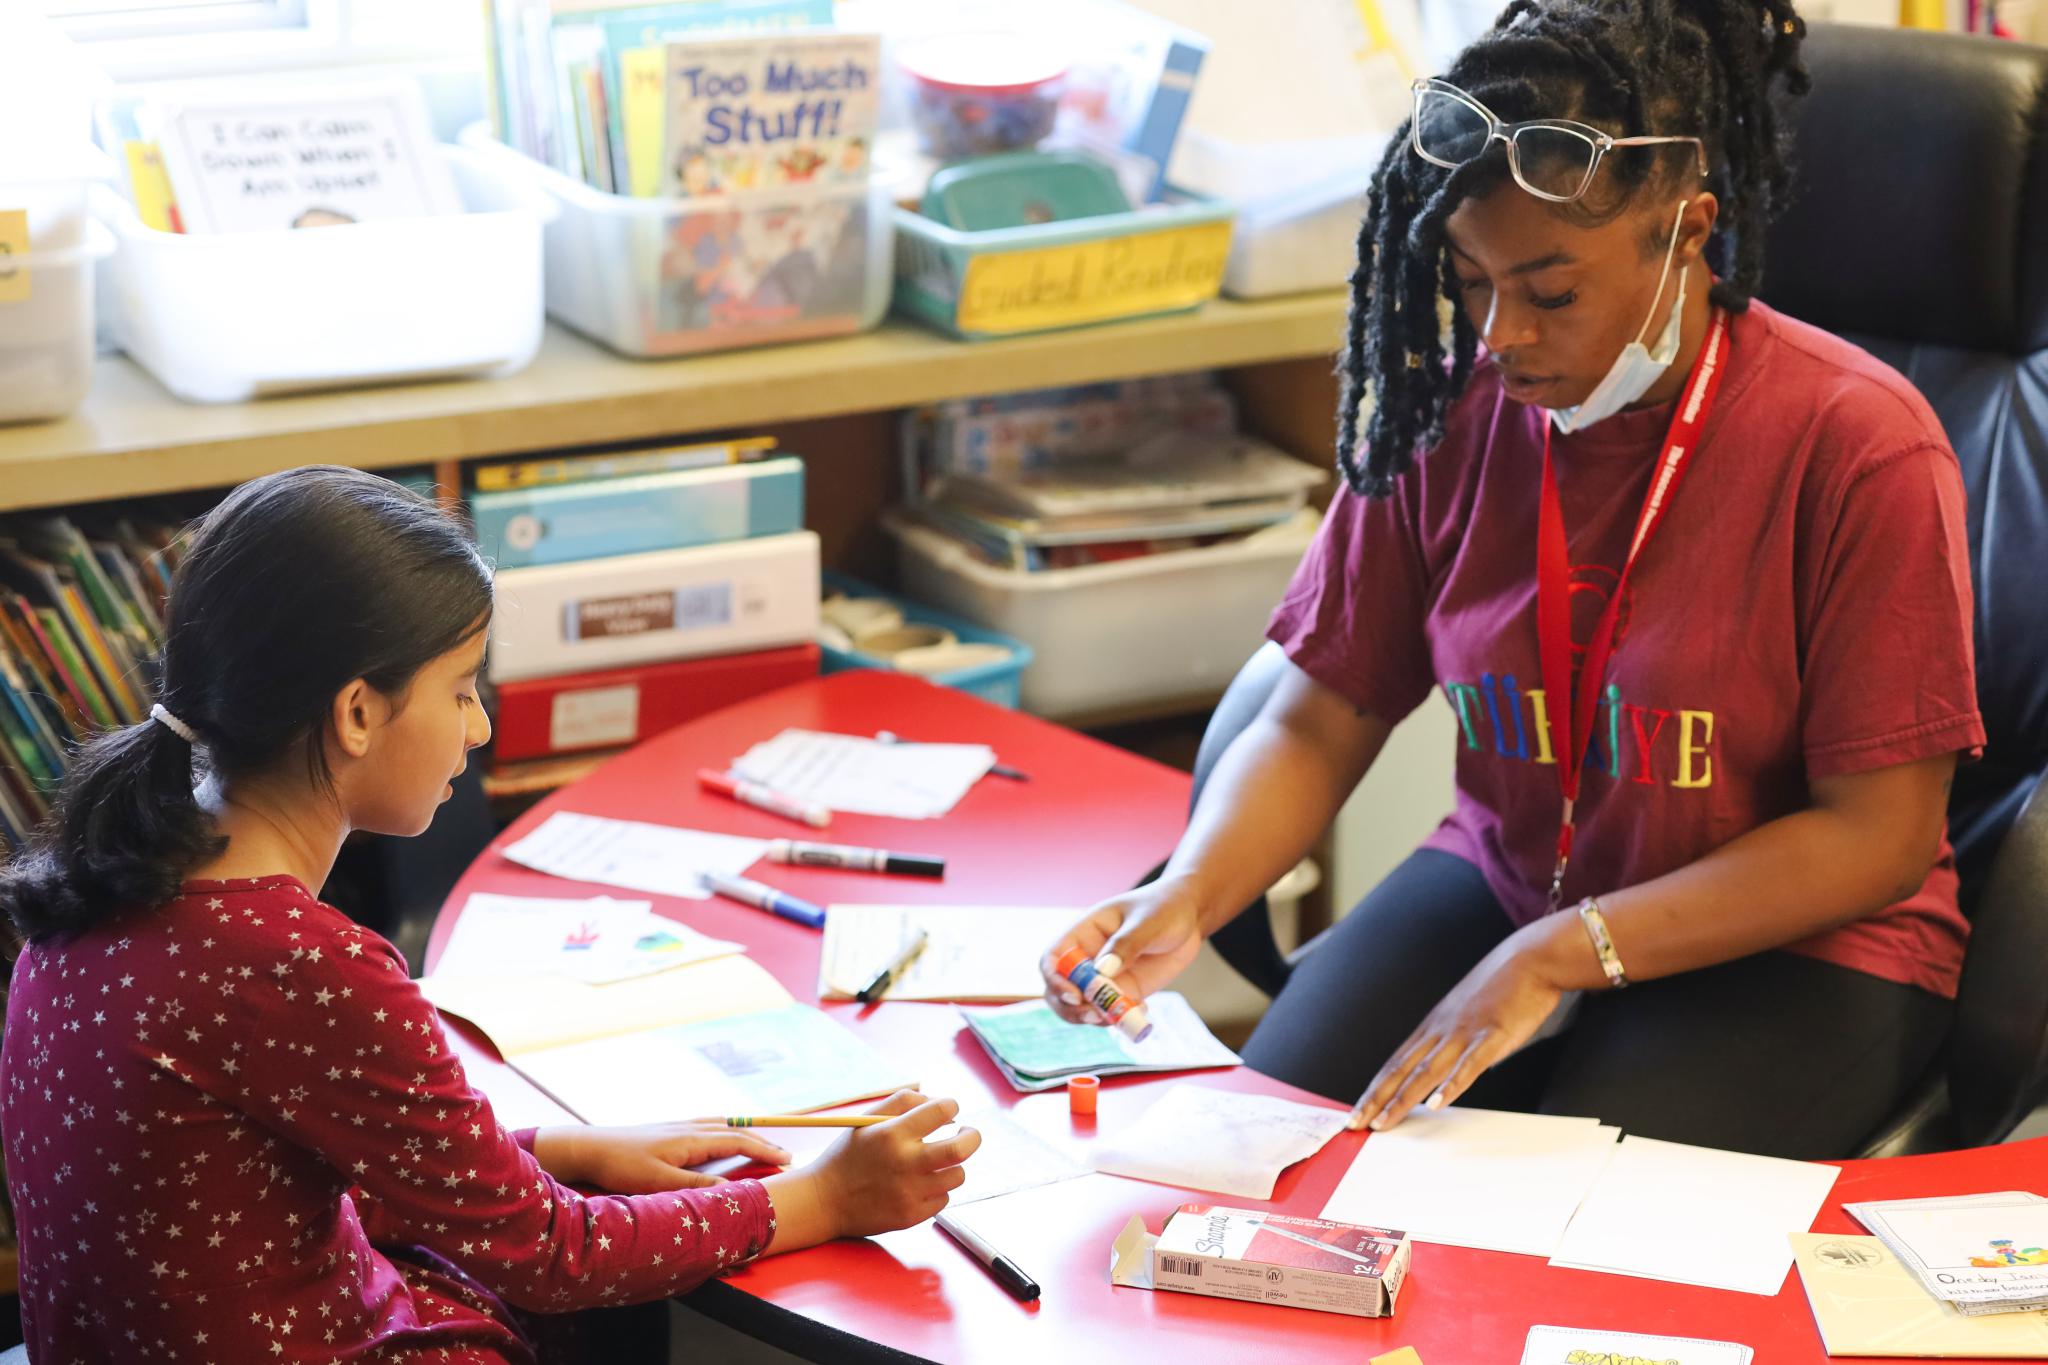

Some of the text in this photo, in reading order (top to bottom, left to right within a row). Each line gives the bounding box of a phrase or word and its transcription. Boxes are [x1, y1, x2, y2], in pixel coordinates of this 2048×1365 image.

[681, 65, 748, 98] Too
[764, 59, 868, 92] Much
[704, 100, 842, 145] Stuff!
[1667, 444, 1685, 466] The
[1195, 1214, 1230, 1259] Sharpie
[1268, 1271, 1280, 1281] AP
[1352, 1263, 1372, 1276] 12
[1265, 1290, 1288, 1300] newell
